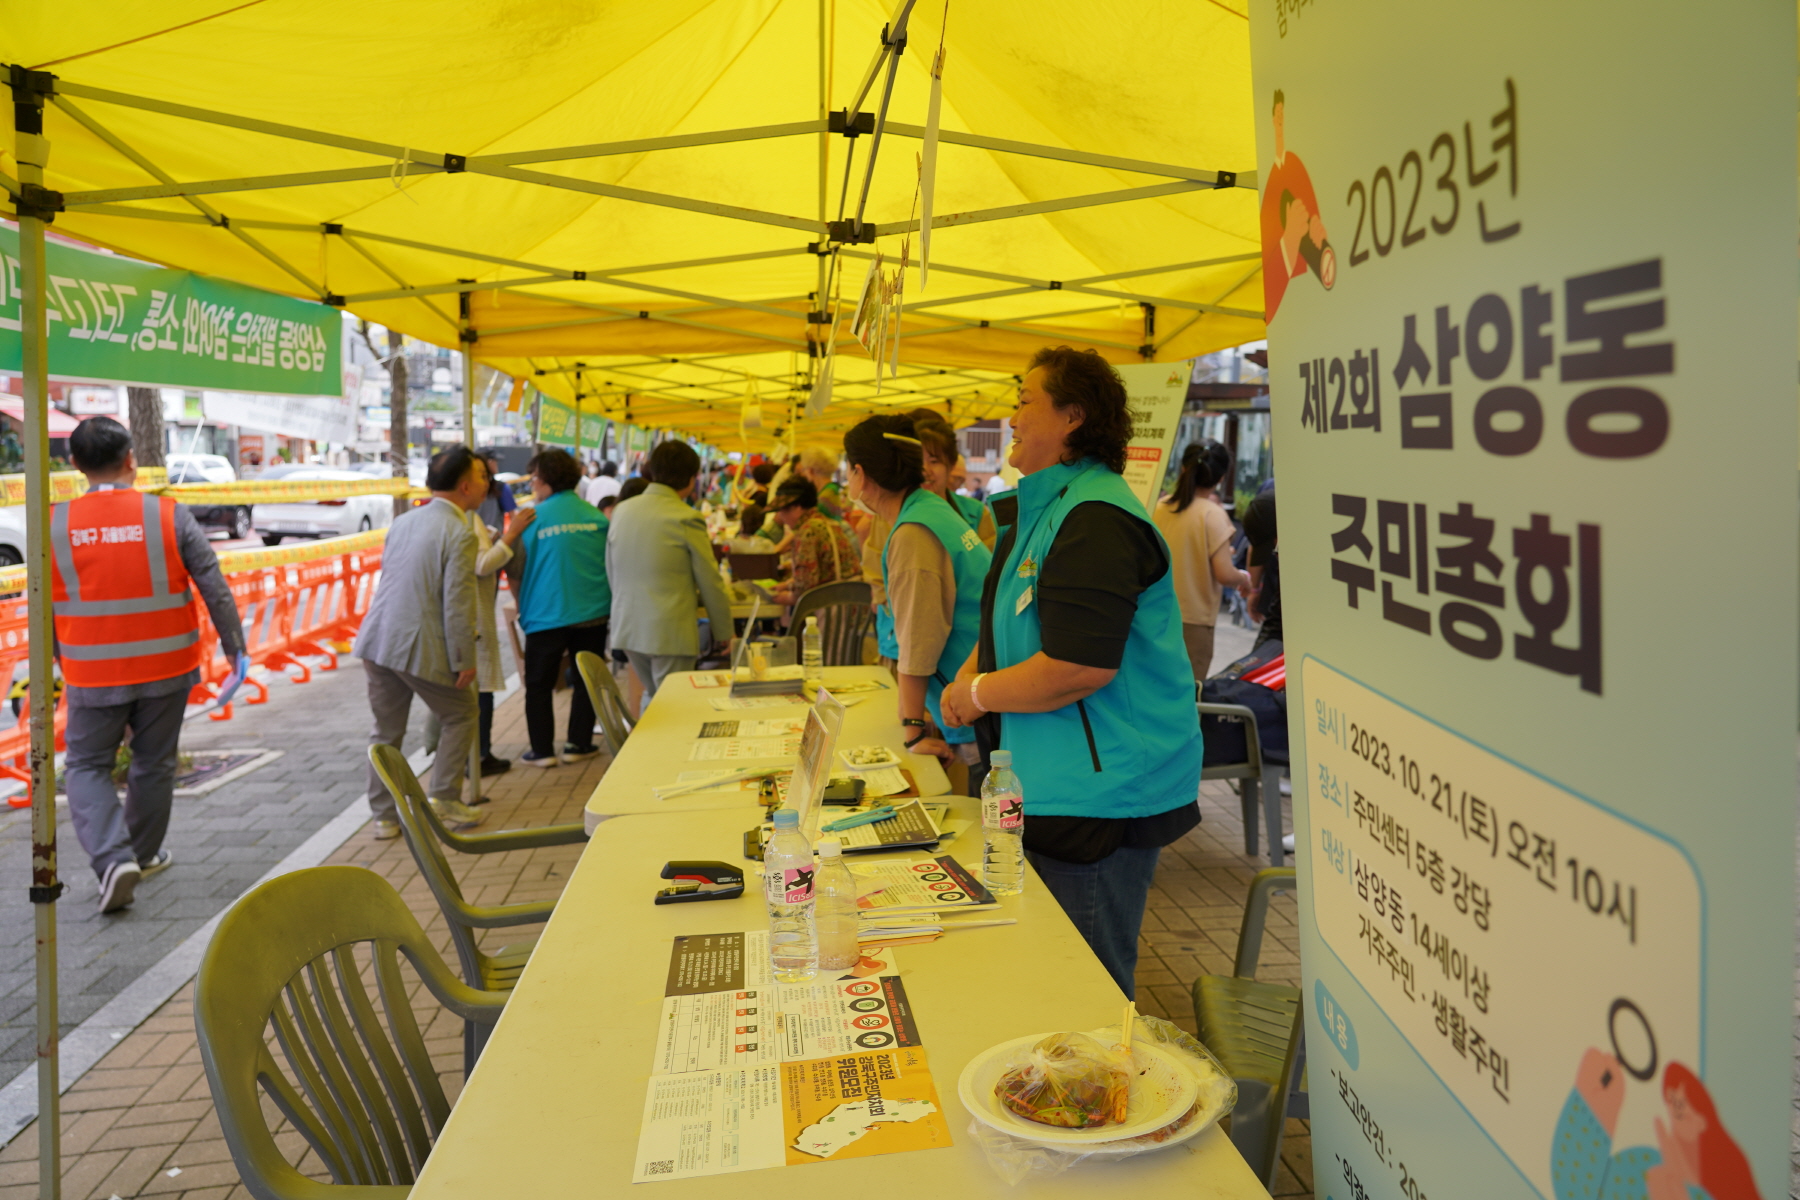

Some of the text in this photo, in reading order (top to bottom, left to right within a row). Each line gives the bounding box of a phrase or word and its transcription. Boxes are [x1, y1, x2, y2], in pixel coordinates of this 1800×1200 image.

[1346, 77, 1522, 267] 2023년
[1299, 256, 1675, 460] 제2회 삼양동
[1331, 493, 1603, 697] 주민총회
[1316, 698, 1338, 745] 일시
[1507, 820, 1557, 891] 오전
[1567, 858, 1638, 946] 10시
[1318, 763, 1492, 932] 장소 주민센터 5층 강당
[1322, 828, 1344, 875] 대상
[1355, 858, 1406, 934] 삼양동
[836, 1057, 863, 1099] 위원모집
[876, 1054, 895, 1081] 2023년
[1324, 996, 1348, 1050] 내용
[1432, 990, 1510, 1105] 생활주민
[859, 1055, 886, 1117] 강북구주민자치회
